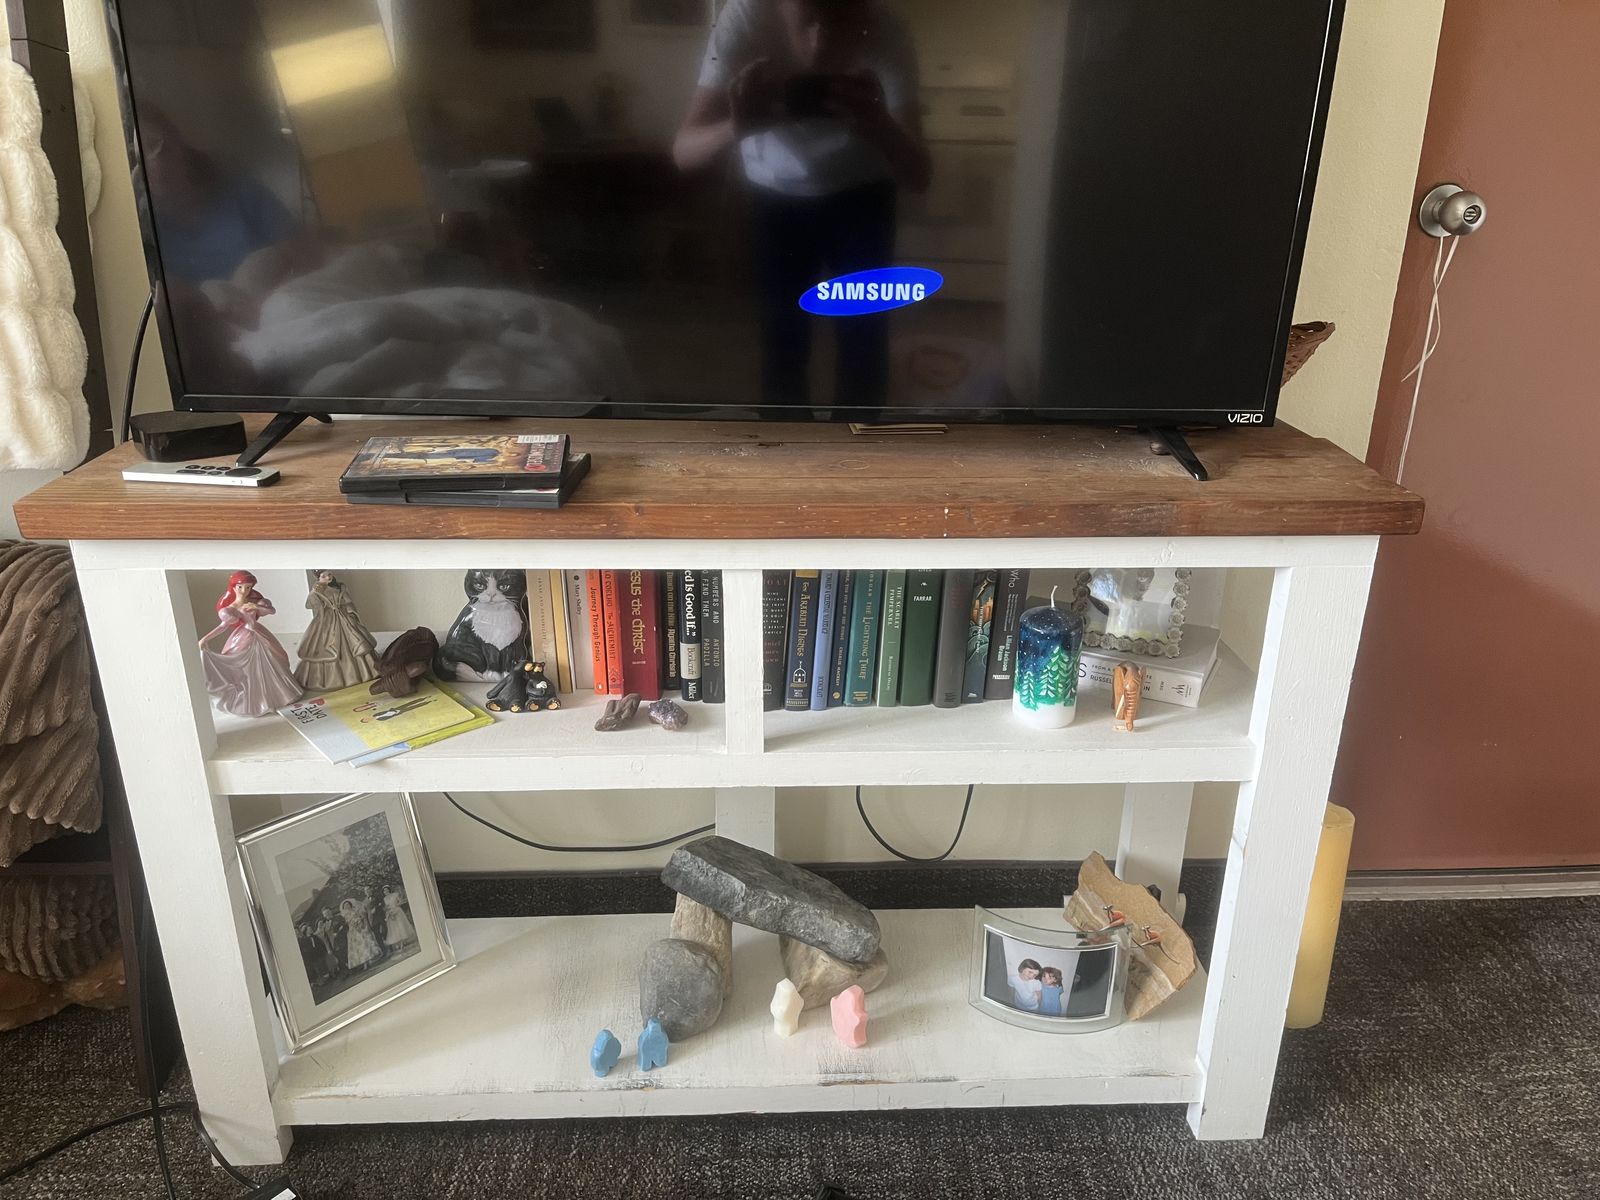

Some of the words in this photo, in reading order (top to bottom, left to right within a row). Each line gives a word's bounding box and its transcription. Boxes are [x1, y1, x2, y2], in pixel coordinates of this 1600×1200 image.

[816, 281, 925, 302] SAMSUNG
[1227, 413, 1264, 424] VIZIO
[630, 569, 642, 596] esus
[685, 583, 695, 592] Is
[1008, 569, 1020, 588] Who
[604, 581, 613, 607] COELHO
[632, 598, 643, 616] the
[685, 593, 696, 620] Good
[887, 588, 895, 626] PIMPERNEL
[592, 613, 600, 640] Through
[861, 616, 874, 657] LIGHTNING
[607, 621, 617, 660] ALCHEMIST
[668, 628, 676, 652] Agatha
[668, 652, 676, 678] Christie
[688, 647, 696, 676] Bookcraft
[997, 645, 1005, 662] Braun
[1002, 650, 1010, 672] Jackson
[858, 658, 869, 680] THIEF
[1090, 674, 1112, 684] RUSSEL
[688, 682, 697, 700] Millet
